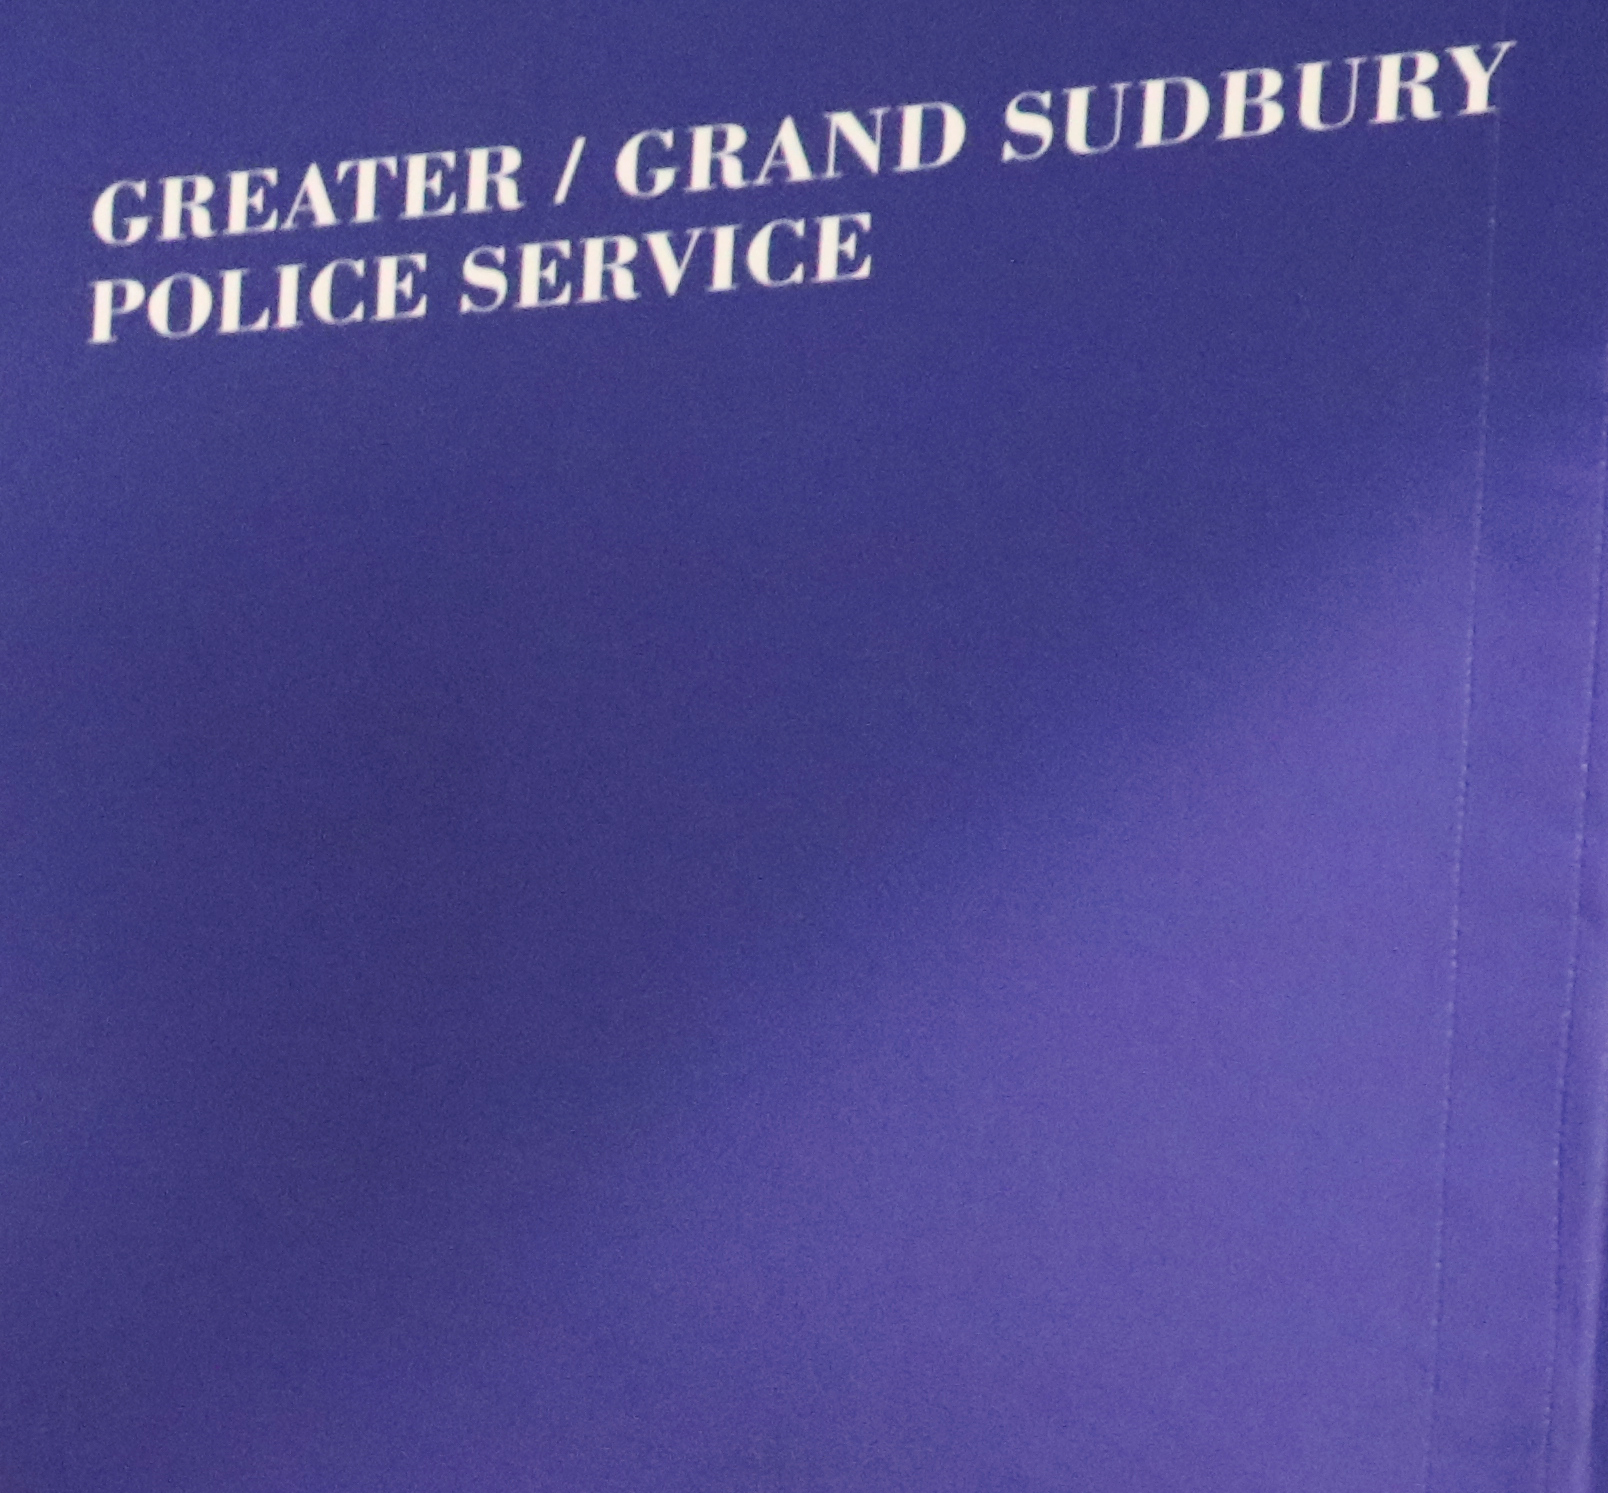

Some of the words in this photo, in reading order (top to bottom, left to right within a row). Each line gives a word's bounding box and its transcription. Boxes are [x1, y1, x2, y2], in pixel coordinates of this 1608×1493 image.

[92, 146, 524, 245] GREATER
[555, 136, 585, 205] /
[616, 102, 966, 197] GRAND
[1002, 41, 1515, 162] SUDBURY
[90, 253, 427, 344] POLICE
[460, 212, 871, 313] SERVICE
